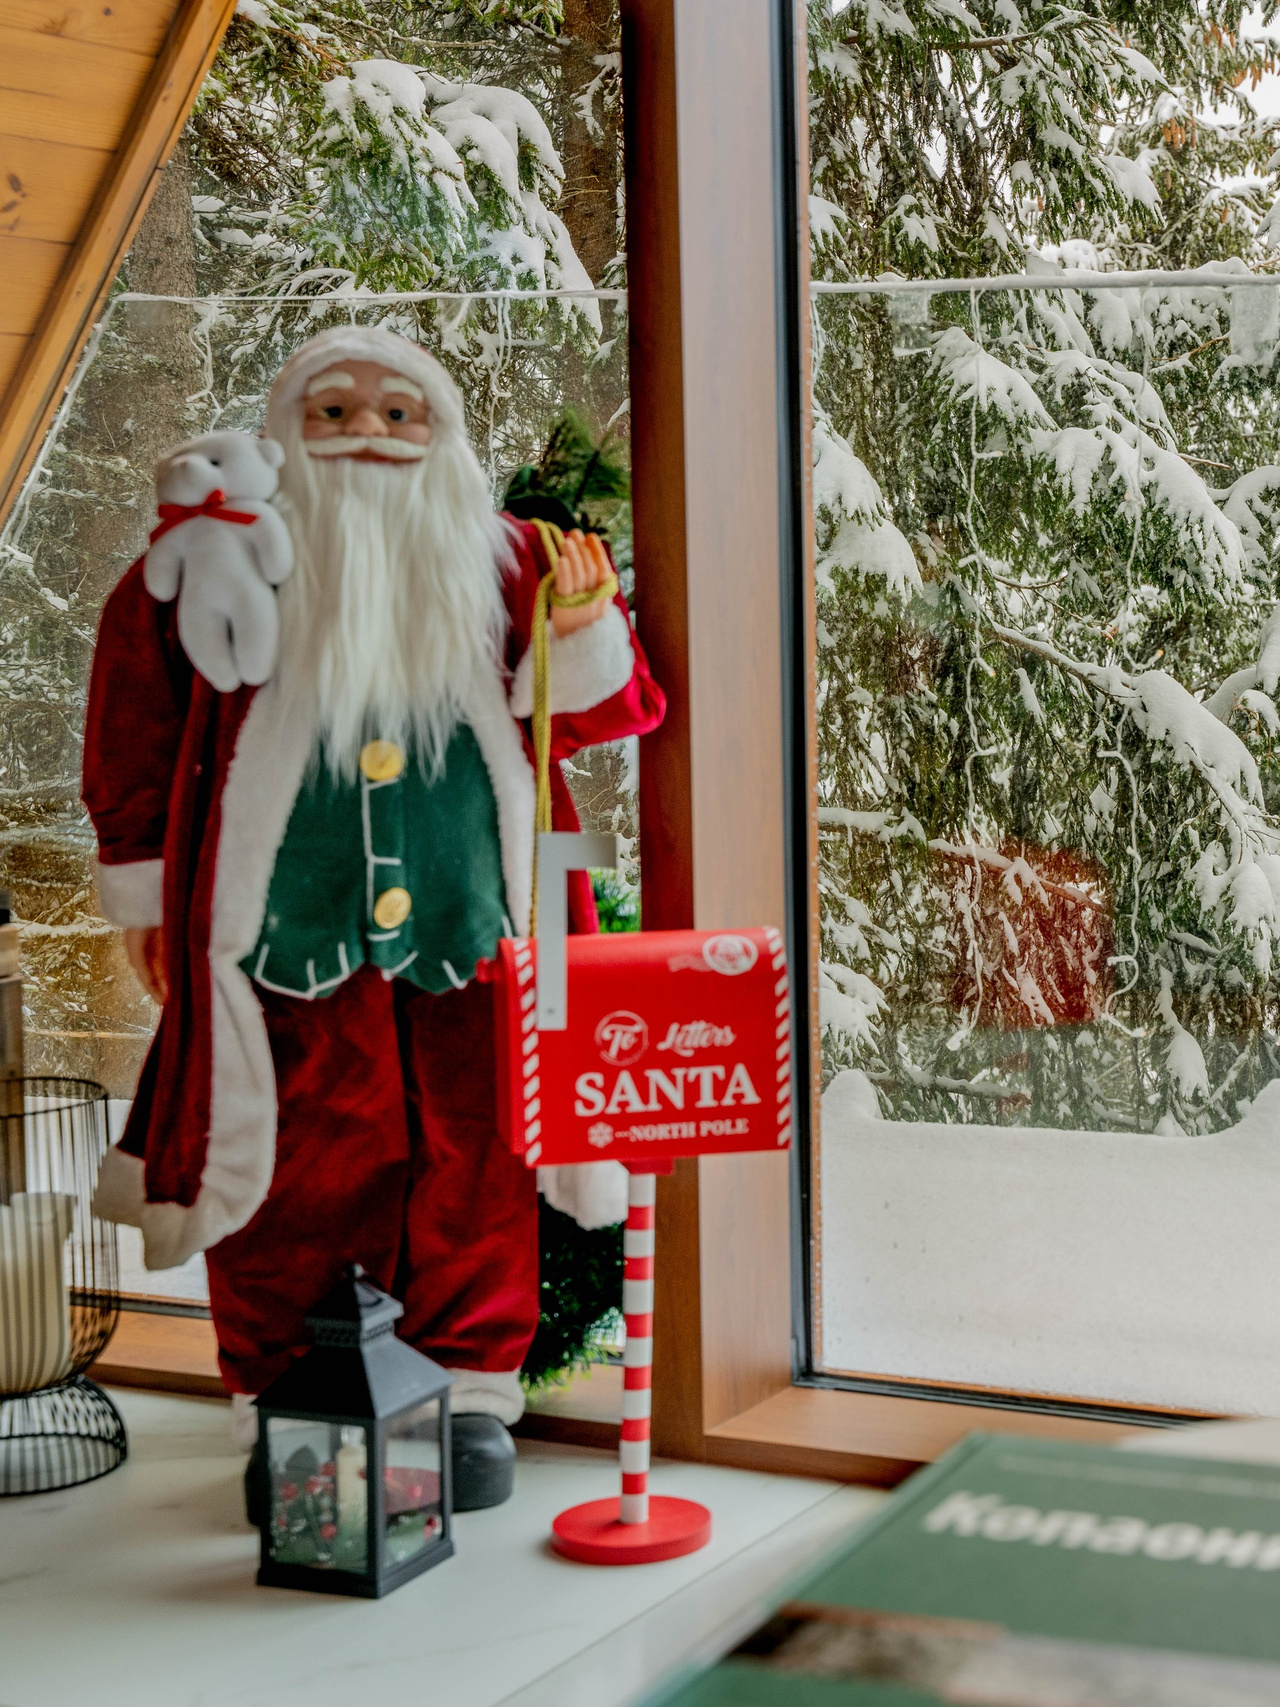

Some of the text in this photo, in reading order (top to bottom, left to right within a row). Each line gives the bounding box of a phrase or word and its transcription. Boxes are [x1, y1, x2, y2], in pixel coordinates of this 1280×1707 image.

[601, 1020, 737, 1059] To Letters
[574, 1062, 762, 1118] SANTA
[630, 1118, 750, 1142] NORTH POLE
